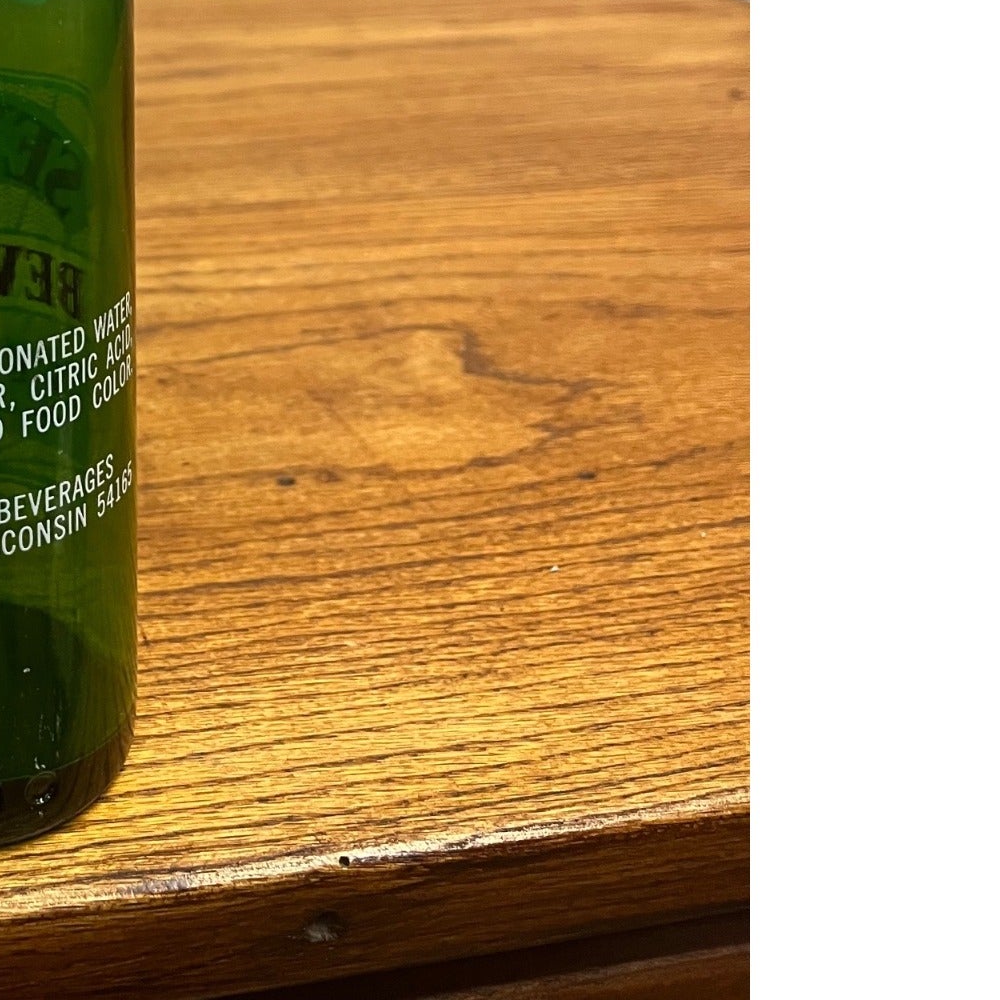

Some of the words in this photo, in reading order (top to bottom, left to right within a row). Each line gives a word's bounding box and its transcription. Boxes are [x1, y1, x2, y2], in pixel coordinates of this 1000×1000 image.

[93, 291, 133, 343] WATER,
[30, 353, 98, 402] CITRIC
[21, 394, 81, 437] FOOD
[97, 460, 132, 518] 54165
